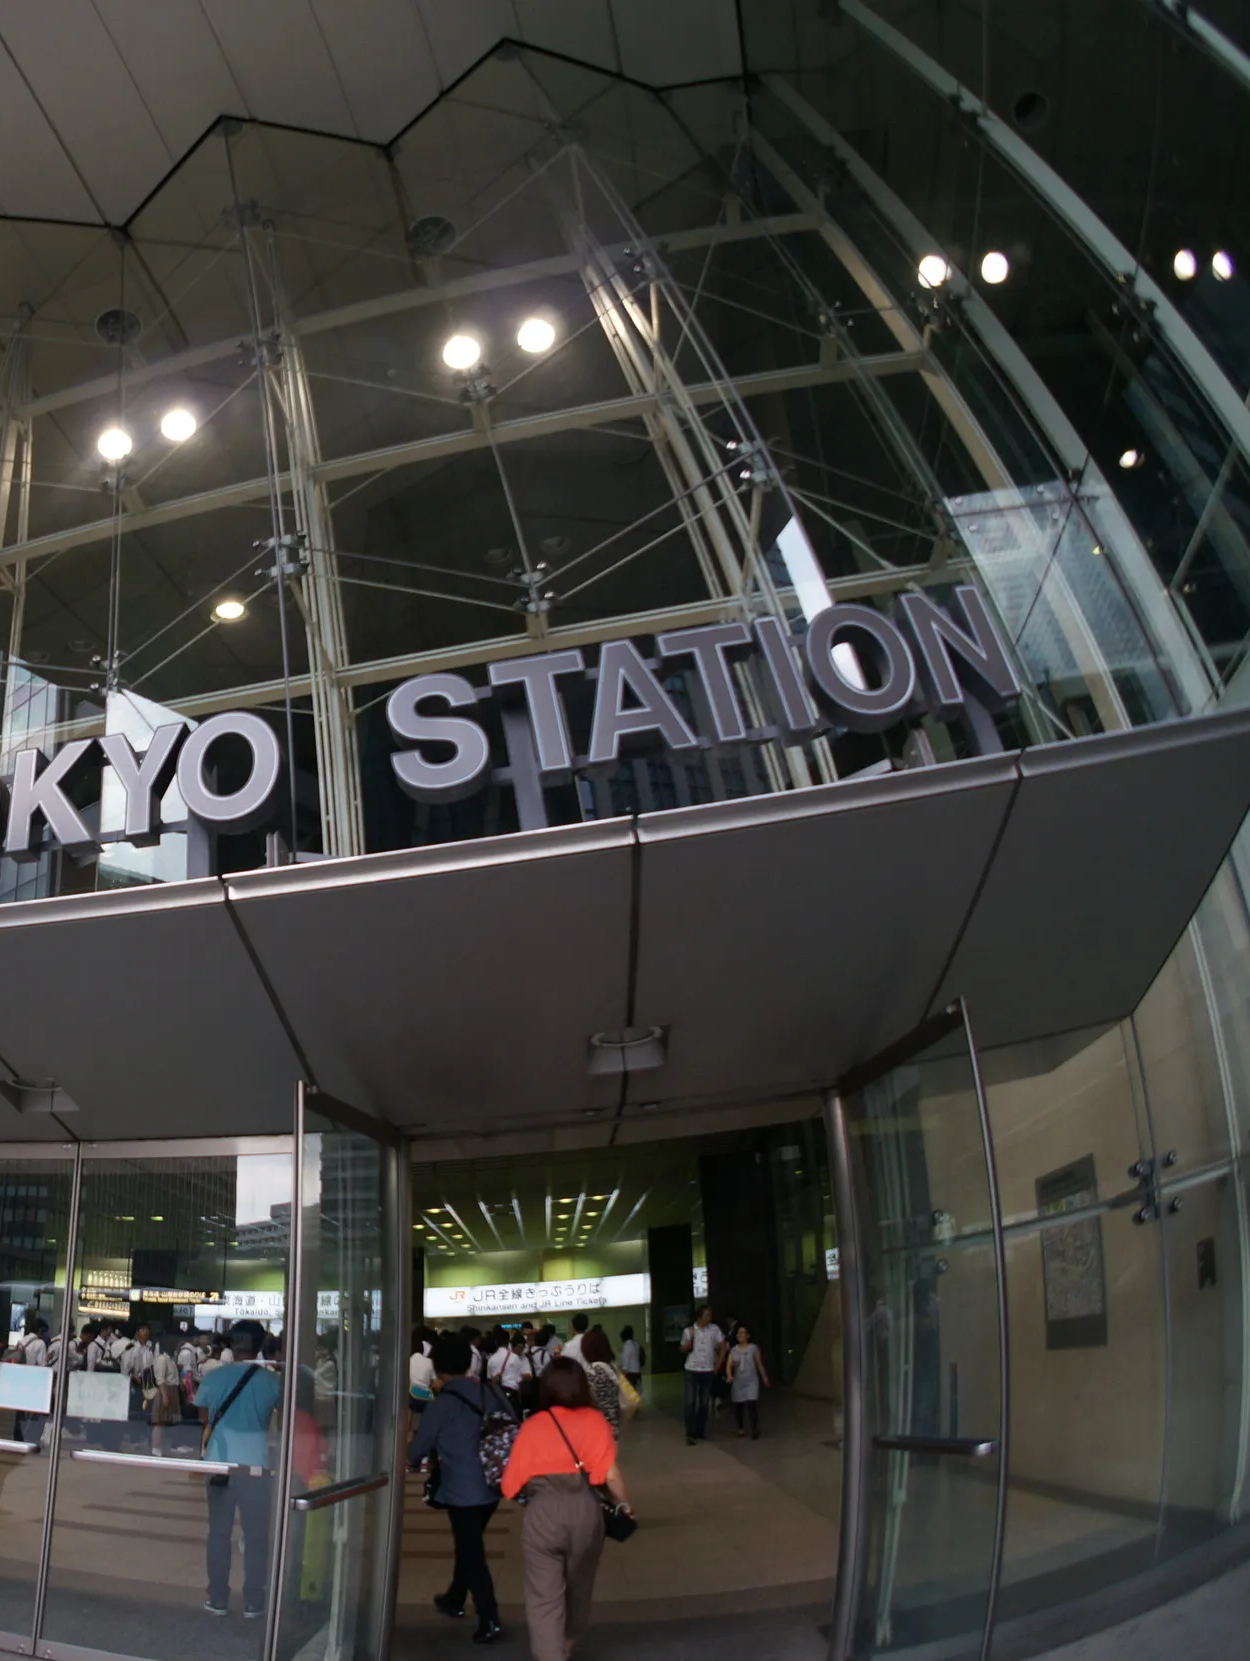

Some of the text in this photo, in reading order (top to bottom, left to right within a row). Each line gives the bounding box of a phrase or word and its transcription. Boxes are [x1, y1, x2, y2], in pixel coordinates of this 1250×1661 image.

[386, 584, 1022, 793] STATION
[449, 1290, 466, 1301] JR
[472, 1282, 601, 1303] JR全線きっぷうりば
[466, 1296, 608, 1313] Shinkansen and JR Line Tickets
